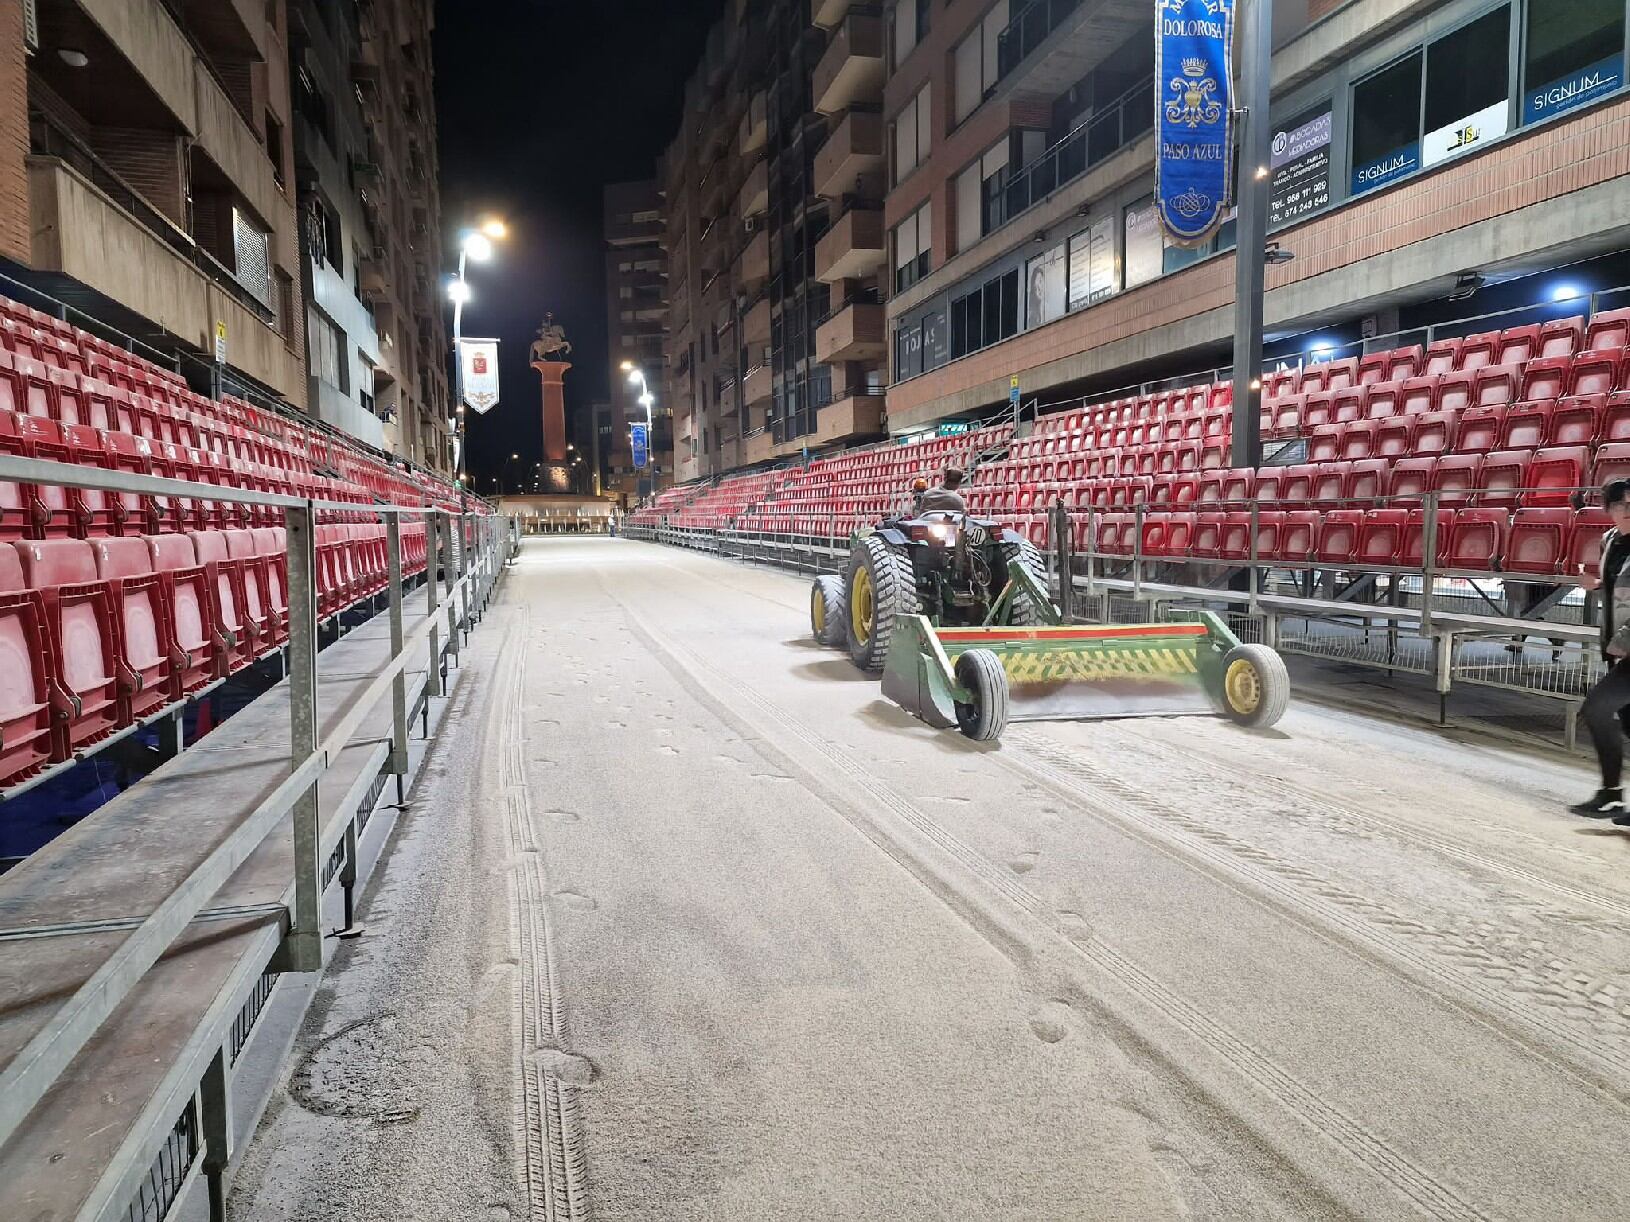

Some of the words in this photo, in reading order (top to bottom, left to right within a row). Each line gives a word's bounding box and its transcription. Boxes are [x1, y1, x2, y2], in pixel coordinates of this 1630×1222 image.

[1164, 18, 1223, 39] DOLOROSA
[1533, 71, 1602, 110] SIGNUM
[1163, 142, 1190, 160] PASO
[1192, 143, 1222, 160] AZUL
[1358, 154, 1405, 184] SIGNUM
